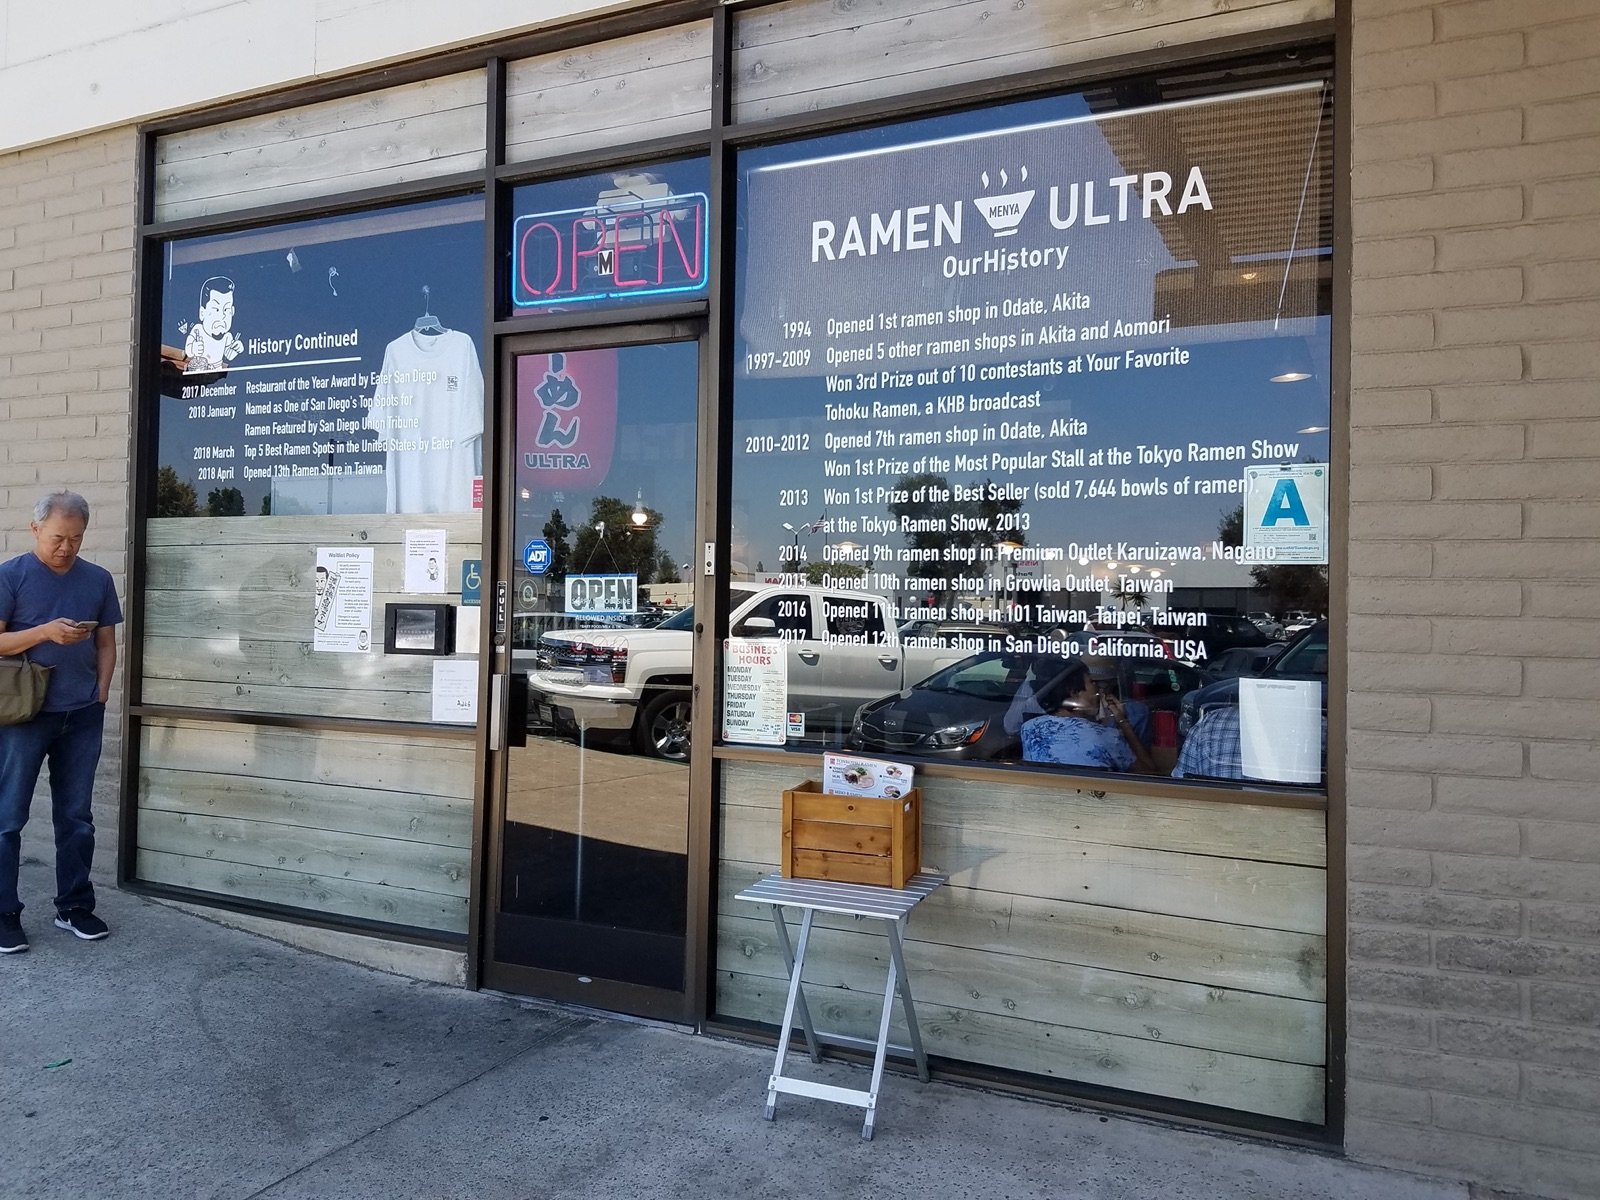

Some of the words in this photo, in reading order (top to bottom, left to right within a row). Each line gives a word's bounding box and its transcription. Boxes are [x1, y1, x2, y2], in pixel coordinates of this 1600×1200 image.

[812, 200, 962, 262] RAMEN
[1049, 166, 1213, 229] ULTRA
[989, 203, 1020, 219] MENYA
[520, 203, 701, 295] OPEN
[599, 251, 613, 274] M
[943, 245, 1069, 279] OurHistory
[783, 321, 812, 339] 1994
[827, 314, 874, 339] Opened
[879, 312, 898, 330] 1st
[901, 310, 943, 328] ramen
[948, 304, 980, 326] shop
[986, 301, 998, 319] in
[1003, 297, 1047, 318] Odate,
[1052, 292, 1090, 312] Akita
[248, 338, 292, 355] History
[294, 329, 358, 351] Continued
[827, 343, 873, 368] Opened
[877, 342, 885, 358] 5
[889, 339, 922, 358] other
[926, 338, 971, 355] ramen
[974, 332, 1016, 352] shops
[1021, 329, 1034, 346] in
[1039, 324, 1076, 345] Akita
[1080, 321, 1109, 341] and
[1113, 314, 1170, 339] Aomori
[826, 375, 852, 393] Won
[856, 372, 877, 390] 3rd
[881, 368, 913, 389] Prize
[917, 367, 939, 386] out
[942, 365, 957, 383] of
[959, 364, 976, 382] 10
[980, 357, 1064, 380] contestants
[1067, 356, 1083, 373] at
[1086, 352, 1120, 372] Your
[1126, 347, 1190, 370] Favorite
[181, 386, 199, 399] 2017
[200, 383, 237, 397] December
[246, 379, 287, 394] Restaurant
[288, 378, 297, 391] of
[297, 377, 310, 391] the
[311, 376, 329, 389] Year
[330, 373, 357, 388] Award
[358, 372, 369, 389] by
[370, 371, 393, 386] Eater
[394, 370, 410, 384] San
[413, 369, 437, 385] Diego
[189, 406, 206, 419] 2018
[207, 405, 236, 419] January
[245, 401, 271, 415] Named
[273, 402, 282, 413] as
[284, 399, 299, 412] One
[300, 398, 309, 411] of
[310, 397, 325, 411] San
[328, 395, 357, 412] Diego's
[359, 394, 373, 410] Top
[375, 393, 399, 409] Spots
[401, 392, 413, 406] for
[825, 403, 869, 421] Tohoku
[873, 400, 921, 419] Ramen,
[925, 401, 933, 414] a
[937, 396, 965, 413] KHB
[969, 390, 1041, 412] broadcast
[245, 423, 270, 436] Ramen
[272, 420, 306, 435] Featured
[307, 420, 318, 436] by
[319, 419, 335, 432] San
[337, 418, 360, 434] Diego
[362, 416, 385, 431] Union
[387, 415, 419, 429] Tribune
[193, 447, 211, 460] 2018
[212, 445, 235, 459] March
[244, 444, 257, 459] Top
[258, 444, 263, 457] 5
[265, 443, 282, 456] Best
[283, 442, 310, 456] Ramen
[312, 441, 334, 456] Spots
[337, 440, 345, 453] in
[345, 440, 360, 453] the
[362, 438, 387, 452] United
[390, 437, 416, 451] States
[418, 437, 429, 454] by
[431, 436, 454, 450] Eater
[824, 462, 851, 477] Won
[855, 460, 873, 475] 1st
[877, 457, 908, 475] Prize
[912, 457, 927, 474] of
[929, 456, 950, 473] the
[954, 454, 988, 471] Most
[992, 451, 1048, 474] Popular
[1051, 447, 1084, 468] Stall
[1088, 449, 1103, 466] at
[1107, 448, 1131, 466] the
[1137, 445, 1183, 468] Tokyo
[1188, 443, 1245, 462] Ramen
[1251, 440, 1299, 460] Show
[198, 467, 216, 480] 2018
[217, 467, 234, 482] April
[243, 465, 271, 481] Opened
[273, 464, 290, 477] 13th
[292, 464, 319, 477] Ramen
[321, 463, 342, 475] Store
[344, 463, 352, 475] in
[354, 462, 382, 475] Taiwan
[524, 452, 591, 470] ULTRA
[1261, 478, 1311, 526] A
[823, 517, 836, 533] at
[838, 516, 858, 533] the
[861, 515, 897, 536] Tokyo
[901, 515, 947, 532] Ramen
[950, 513, 991, 533] Show,
[996, 512, 1030, 531] 2013
[528, 552, 548, 563] ADT
[779, 545, 807, 561] 2014
[823, 545, 870, 564] Opened
[873, 545, 893, 561] 9th
[897, 547, 940, 562] ramen
[943, 545, 976, 565] shop
[980, 544, 993, 561] in
[1000, 543, 1063, 561] Premium
[1069, 542, 1112, 561] Outlet
[1117, 541, 1206, 561] Karuizawa,
[1212, 541, 1277, 564] Nagano
[571, 578, 633, 611] OPEN
[732, 645, 778, 655] BUSINESS
[778, 628, 807, 646] 2017
[821, 629, 868, 649] Opened
[872, 631, 899, 649] 12th
[903, 633, 946, 650] ramen
[950, 633, 983, 654] shop
[987, 633, 1000, 651] in
[1005, 635, 1031, 654] San
[1037, 636, 1084, 660] Diego,
[1088, 637, 1168, 660] California,
[1174, 640, 1208, 660] USA
[739, 656, 771, 665] HOURS
[727, 683, 761, 692] WEDNESDAY
[727, 692, 756, 700] THURSDAY
[726, 710, 755, 718] SATURDAY
[727, 701, 746, 709] FRIDAY
[726, 719, 749, 727] SUNDAY
